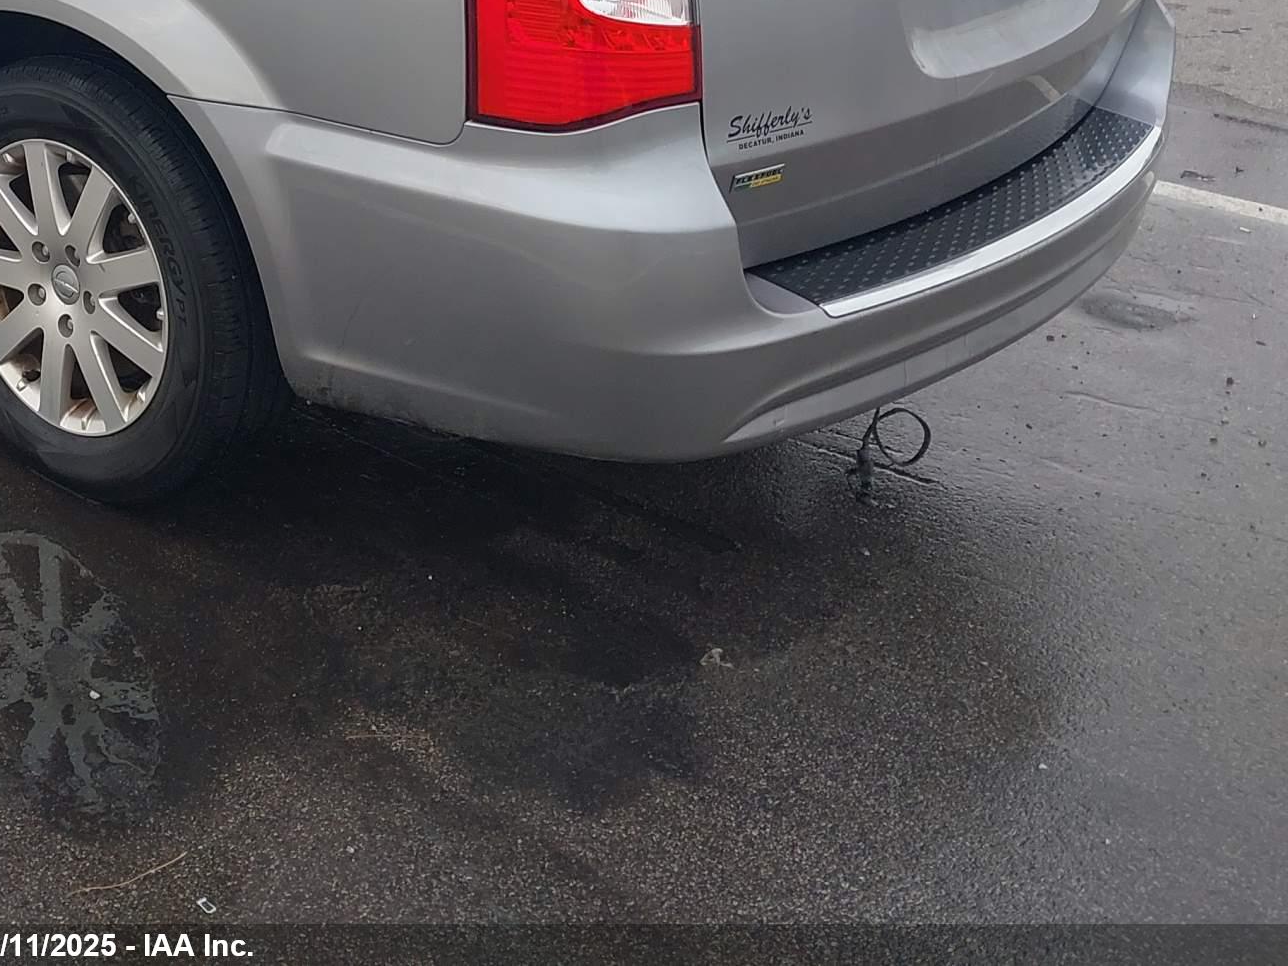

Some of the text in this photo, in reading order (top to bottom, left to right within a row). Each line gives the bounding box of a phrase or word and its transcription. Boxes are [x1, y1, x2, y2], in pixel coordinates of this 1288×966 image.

[727, 105, 812, 138] Shifferly's
[738, 129, 805, 150] DECATUR, INDIANA
